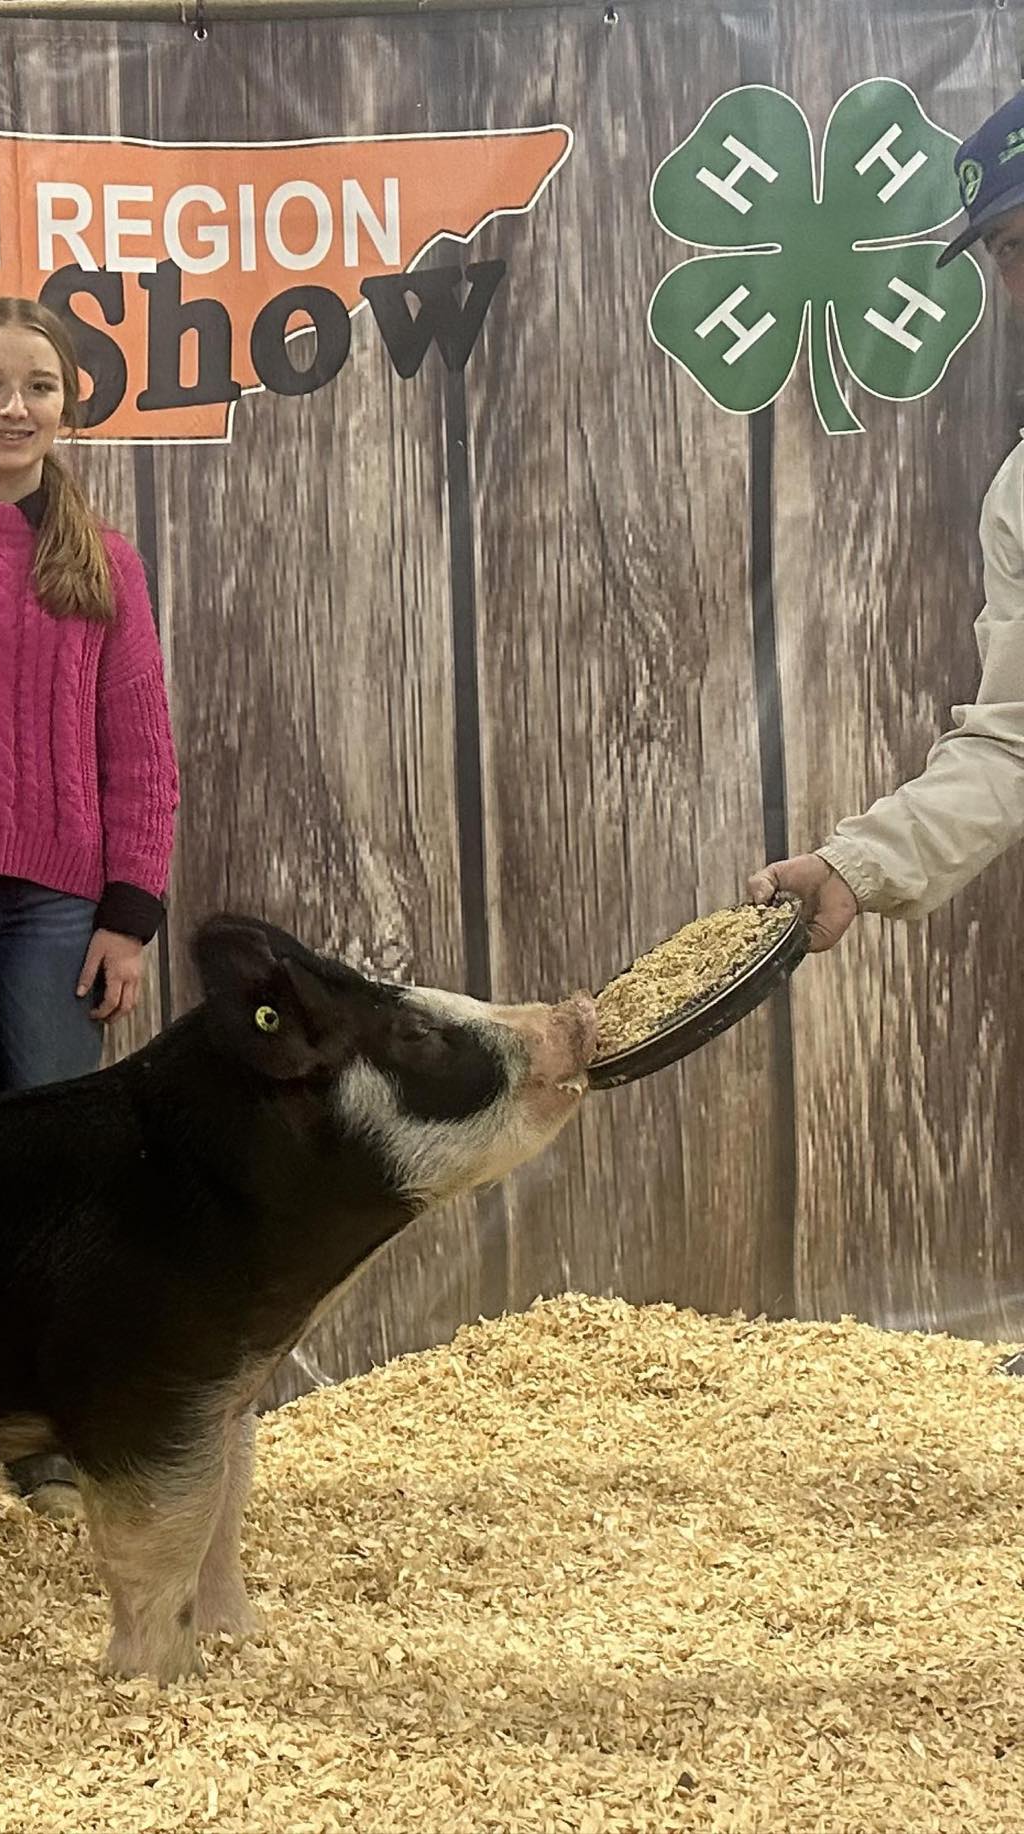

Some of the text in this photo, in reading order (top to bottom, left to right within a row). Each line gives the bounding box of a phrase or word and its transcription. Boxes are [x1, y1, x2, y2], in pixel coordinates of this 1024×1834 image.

[695, 134, 779, 215] H
[854, 122, 929, 204] H
[36, 177, 402, 275] REGION
[36, 259, 506, 430] Show
[694, 284, 777, 366] H
[863, 276, 947, 354] H
